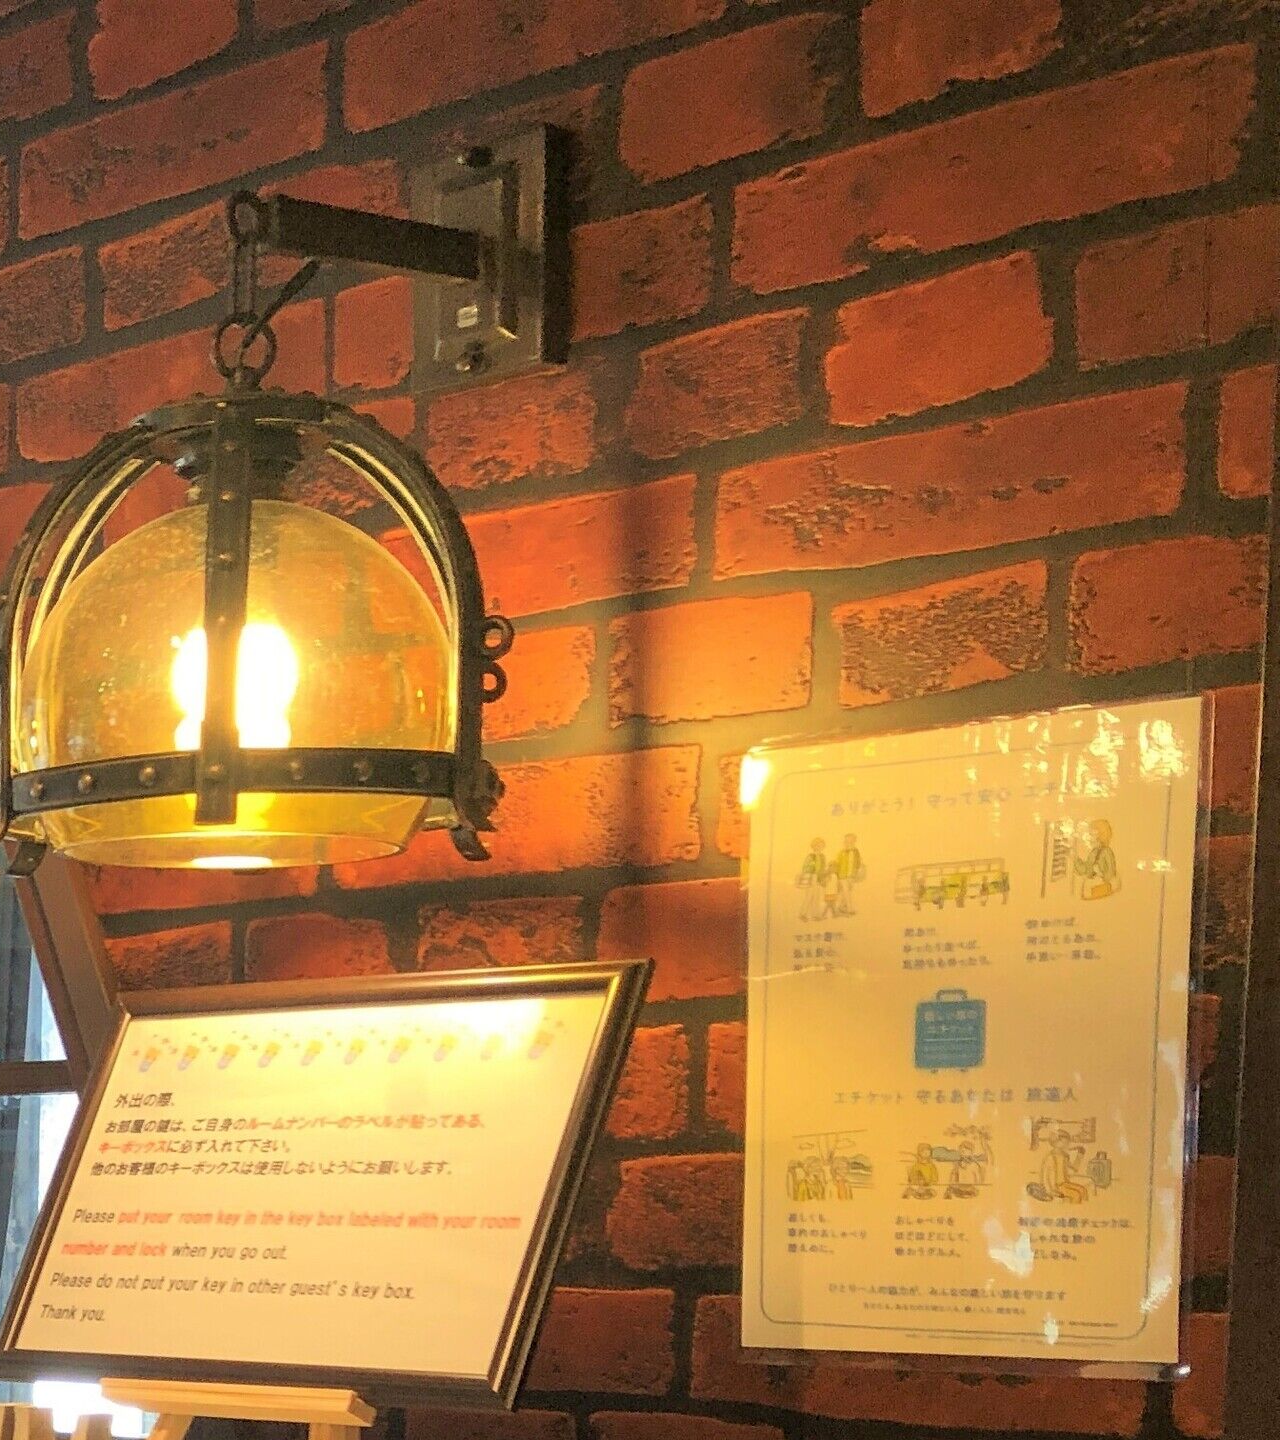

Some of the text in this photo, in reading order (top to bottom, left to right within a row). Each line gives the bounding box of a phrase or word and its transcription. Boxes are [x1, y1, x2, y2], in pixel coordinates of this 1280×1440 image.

[72, 1208, 115, 1224] Please
[117, 1210, 140, 1225] put
[142, 1211, 172, 1225] your
[177, 1212, 214, 1224] room
[216, 1210, 240, 1226] key
[243, 1210, 257, 1225] in
[260, 1211, 284, 1225] the
[288, 1211, 314, 1228] key
[443, 1215, 477, 1230] your
[60, 1241, 109, 1256] number
[111, 1242, 137, 1257] and
[139, 1242, 167, 1257] lock
[171, 1243, 207, 1258] when
[209, 1245, 235, 1260] you
[239, 1246, 258, 1261] go
[49, 1272, 92, 1288] Please
[96, 1272, 113, 1288] do
[115, 1276, 137, 1290] not
[140, 1275, 165, 1292] put
[167, 1278, 199, 1293] your
[201, 1277, 227, 1295] key
[230, 1277, 244, 1293] in
[247, 1279, 286, 1295] other
[351, 1281, 380, 1300] key
[383, 1282, 416, 1300] box.
[40, 1303, 106, 1322] Thank you.
